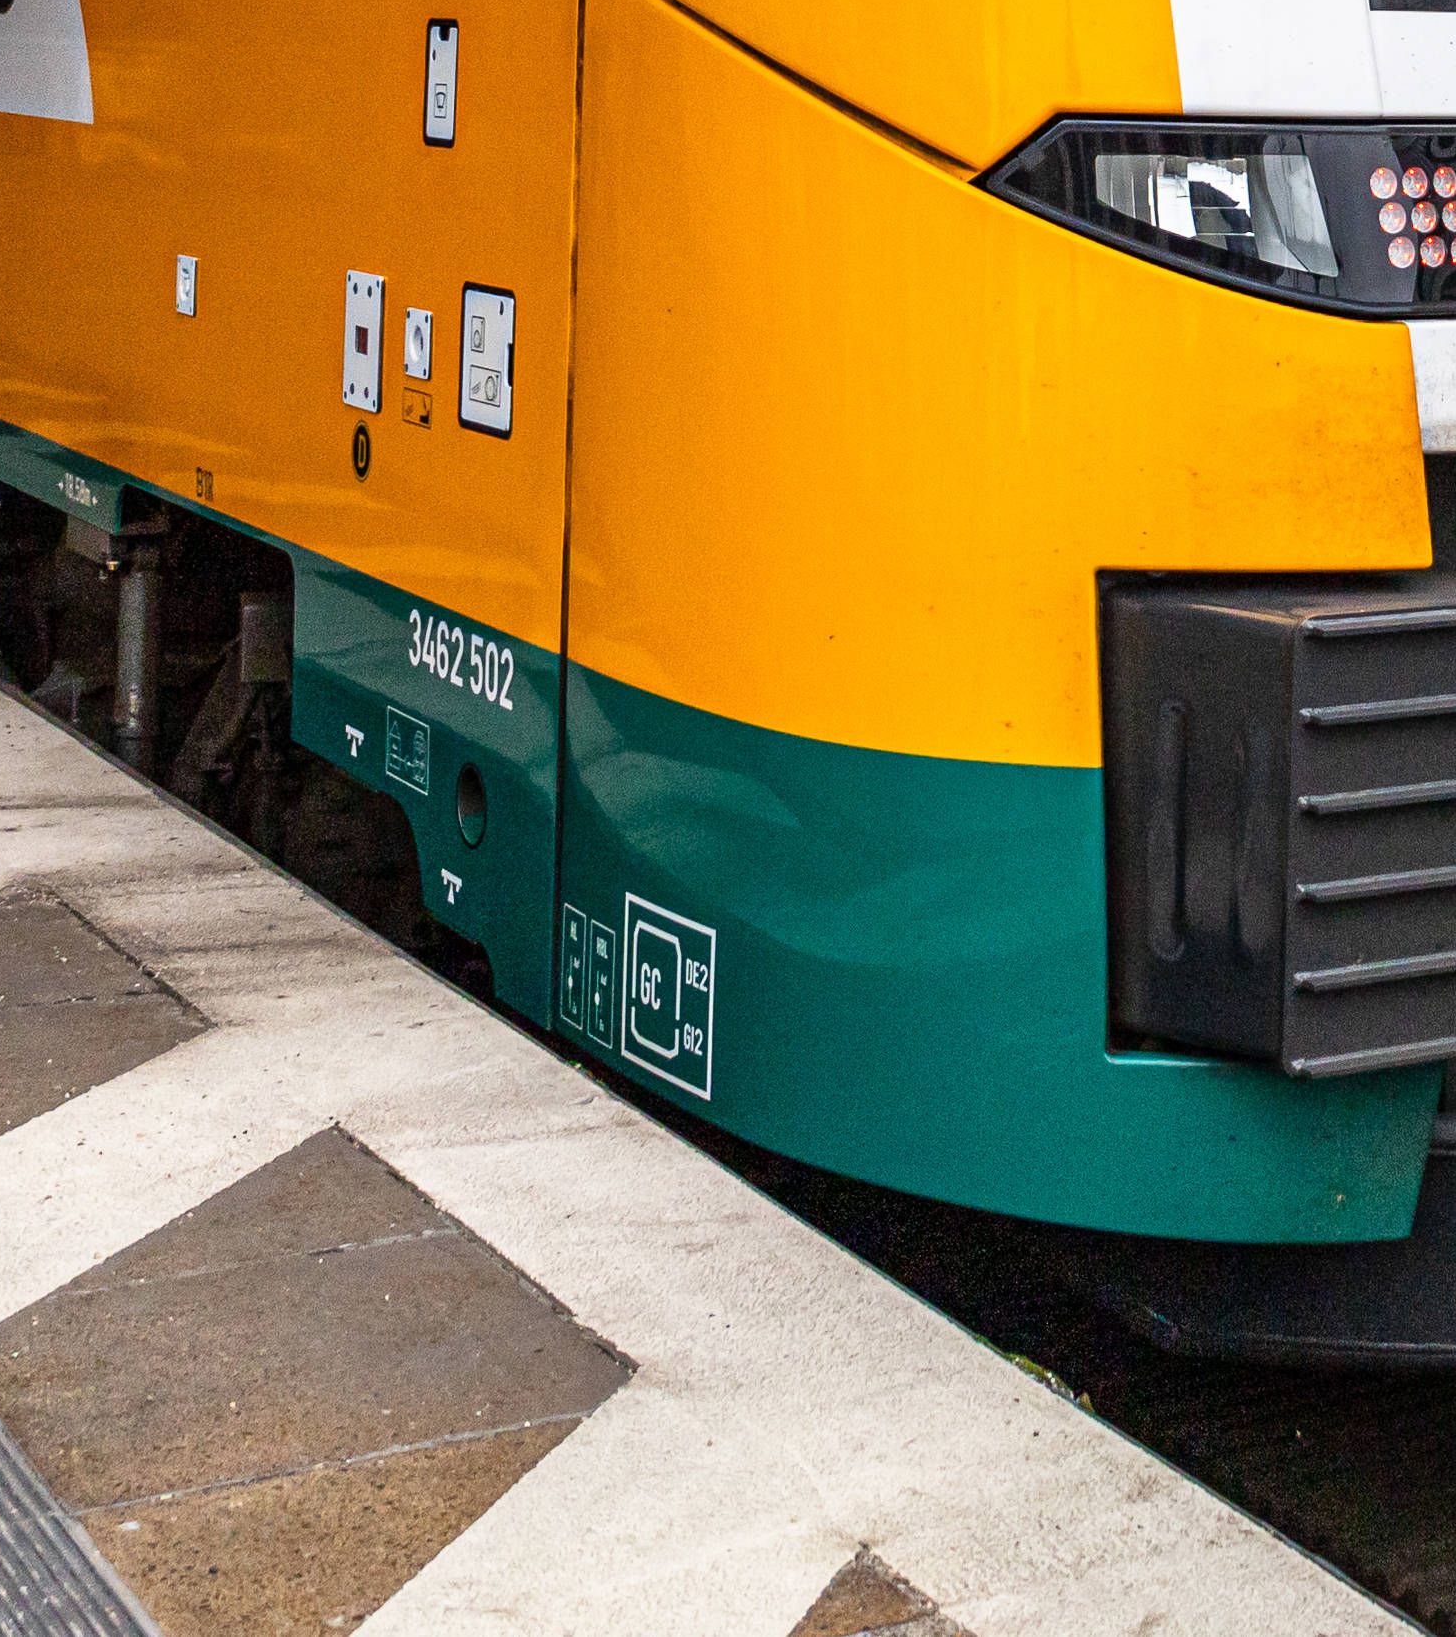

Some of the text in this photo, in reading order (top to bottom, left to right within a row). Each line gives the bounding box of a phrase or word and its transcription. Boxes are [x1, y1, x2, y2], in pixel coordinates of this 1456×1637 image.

[409, 608, 514, 711] 3462 502
[640, 963, 662, 1011] GC
[685, 958, 709, 993] DE2
